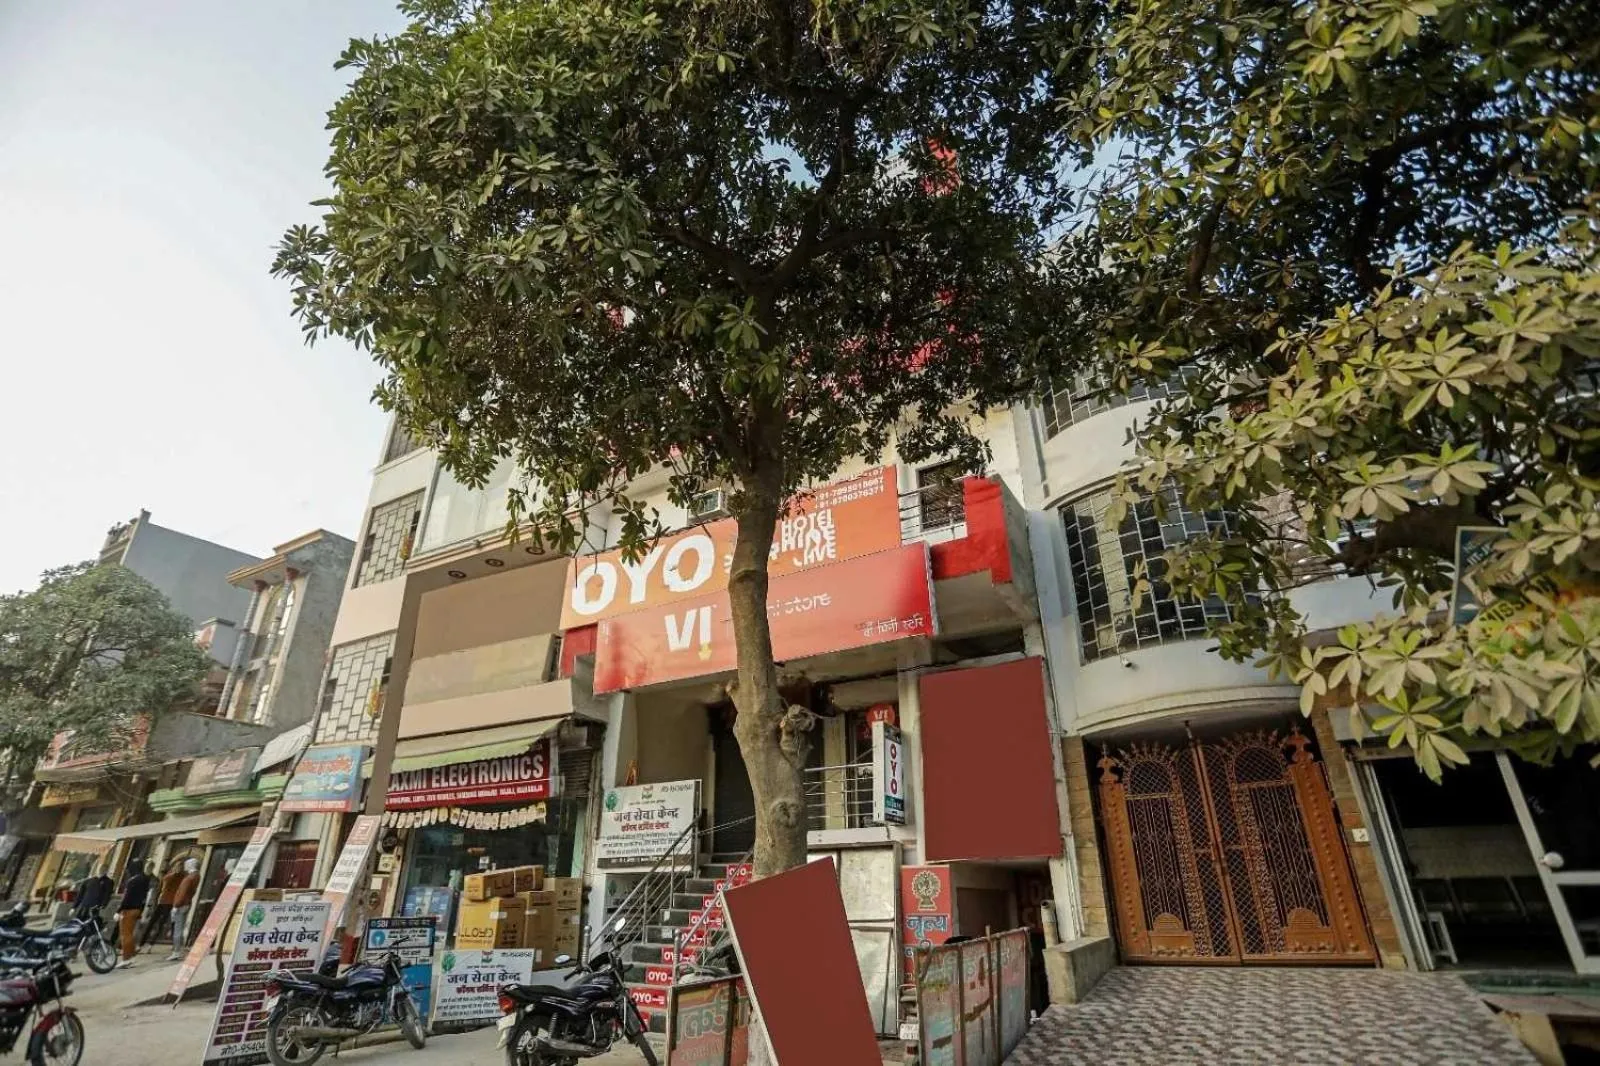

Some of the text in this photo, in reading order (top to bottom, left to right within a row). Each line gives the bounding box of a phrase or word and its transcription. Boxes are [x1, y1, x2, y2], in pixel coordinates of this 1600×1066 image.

[571, 535, 715, 615] OYO
[431, 755, 544, 788] ELECTRONICS
[890, 743, 898, 795] OYO
[377, 920, 388, 928] SBI
[242, 926, 321, 945] जन सेवा केन्द्र
[447, 973, 468, 984] जन
[471, 970, 496, 983] सेवा
[648, 971, 668, 982] OYO
[632, 992, 651, 1004] OYO
